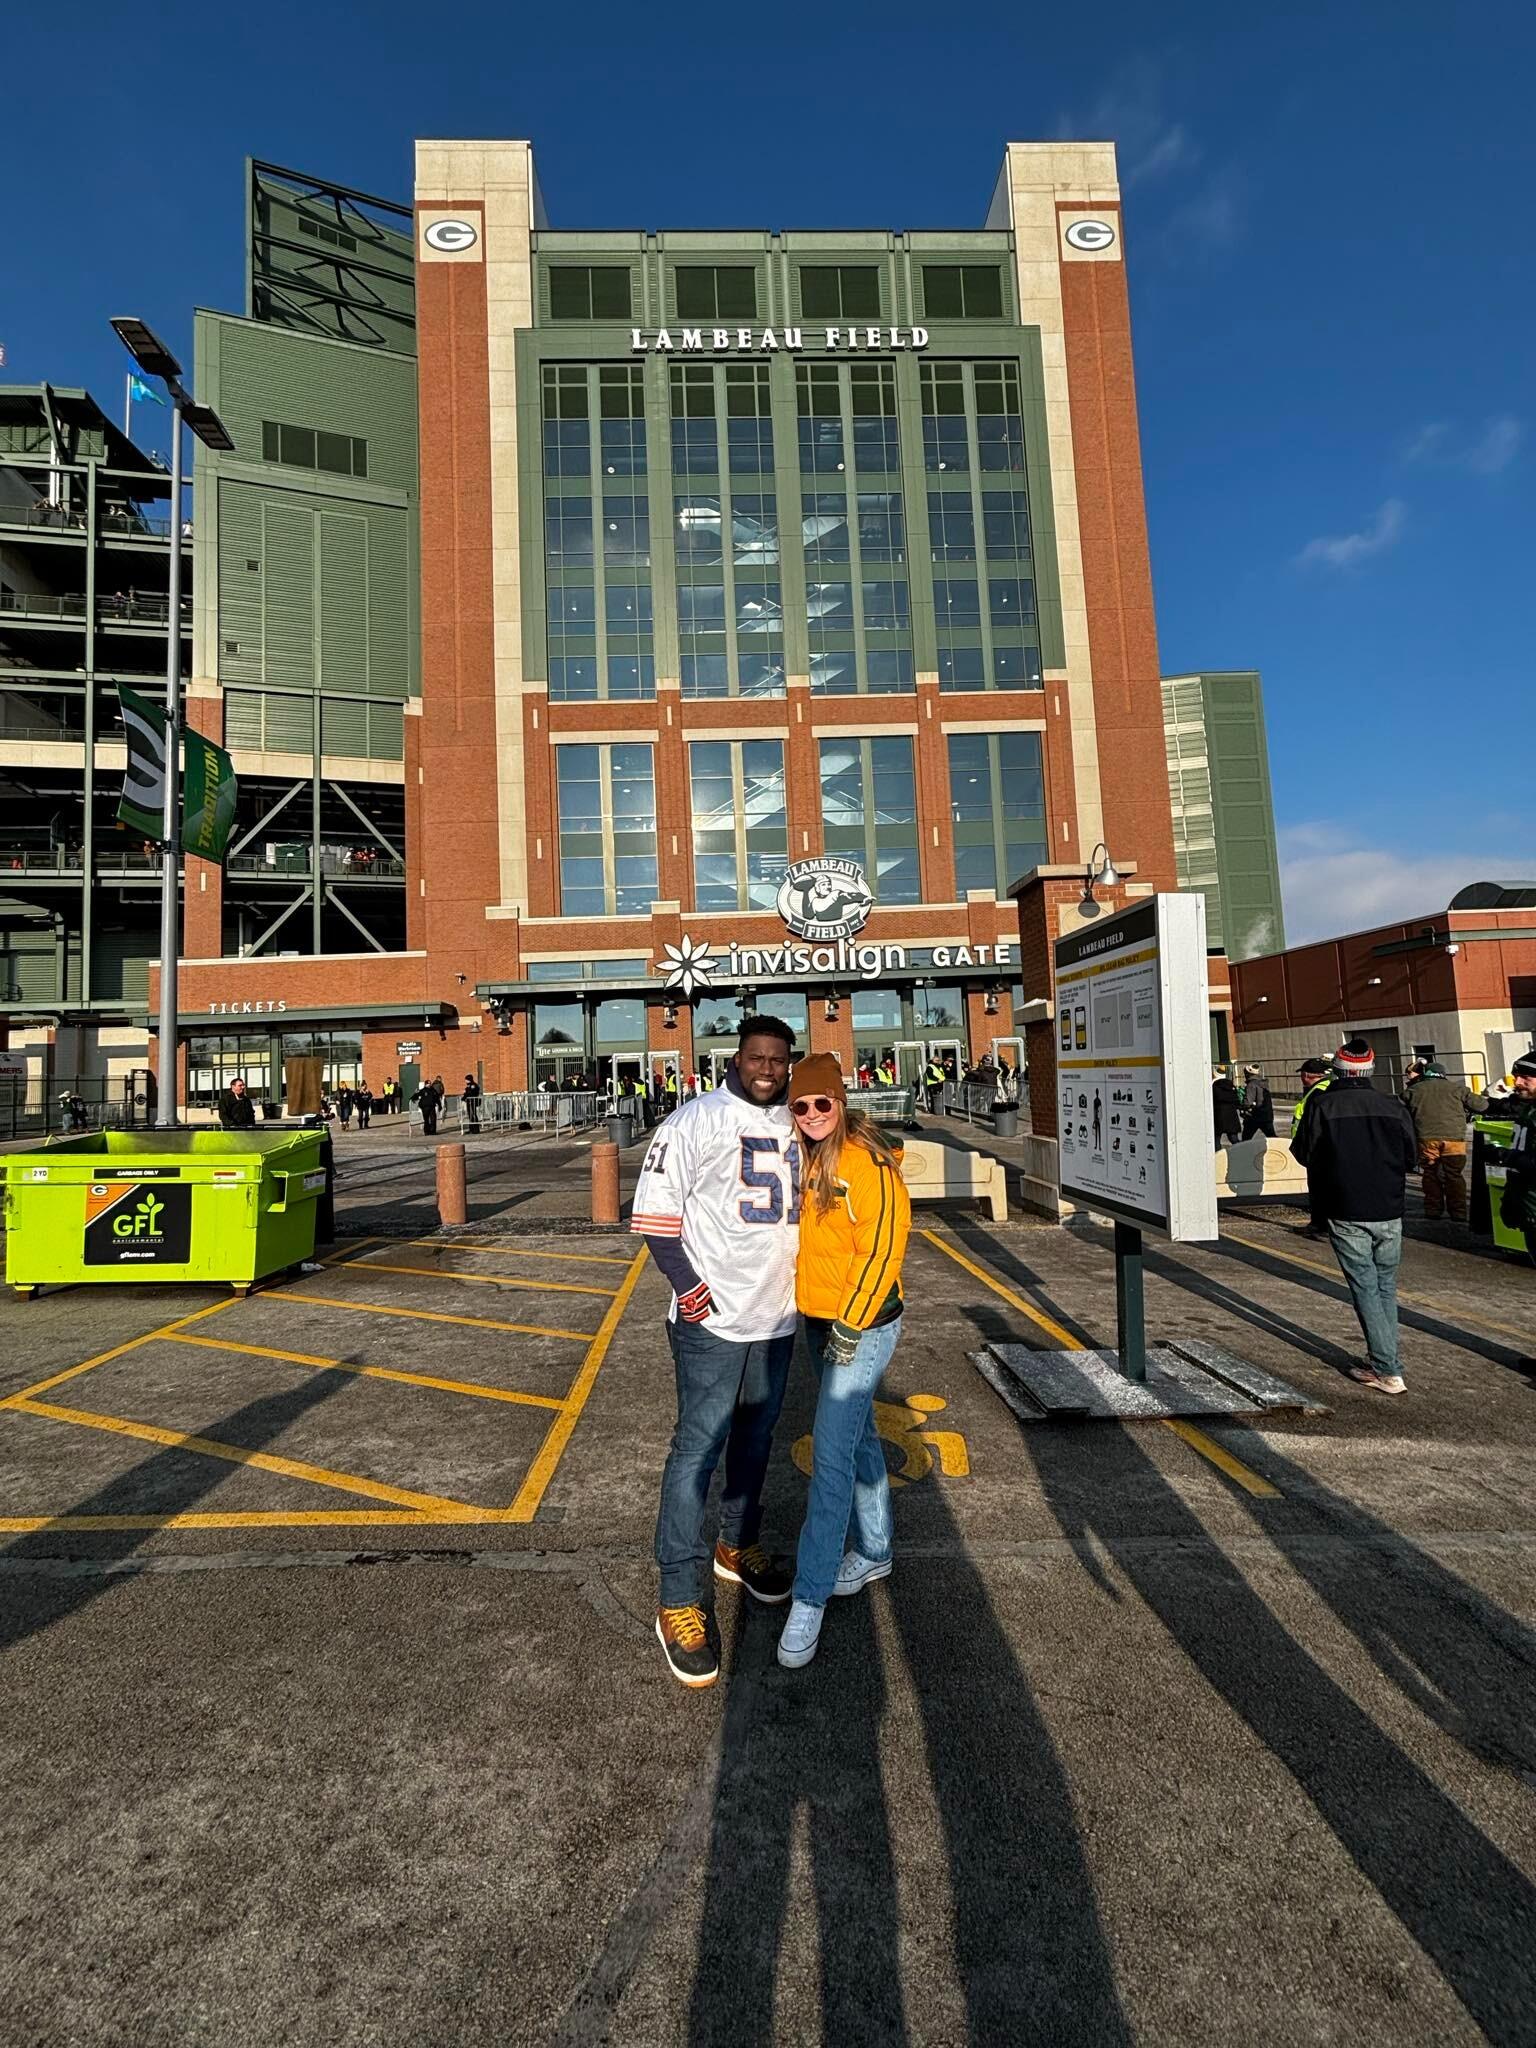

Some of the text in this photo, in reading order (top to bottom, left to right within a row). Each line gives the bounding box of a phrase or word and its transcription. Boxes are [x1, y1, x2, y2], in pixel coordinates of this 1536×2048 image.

[424, 219, 478, 252] G
[1065, 219, 1115, 251] G
[631, 326, 929, 351] LAMBEAU FIELD
[198, 745, 220, 848] TRADITION
[791, 860, 855, 878] LAMBEAU
[806, 925, 846, 939] FIELD
[1078, 931, 1124, 956] LAMBEAU FIELD
[730, 938, 1011, 979] invisalign GATE
[208, 1000, 287, 1015] TICKETS
[644, 1141, 669, 1174] 51
[739, 1135, 801, 1224] 51
[113, 1208, 164, 1237] GFL
